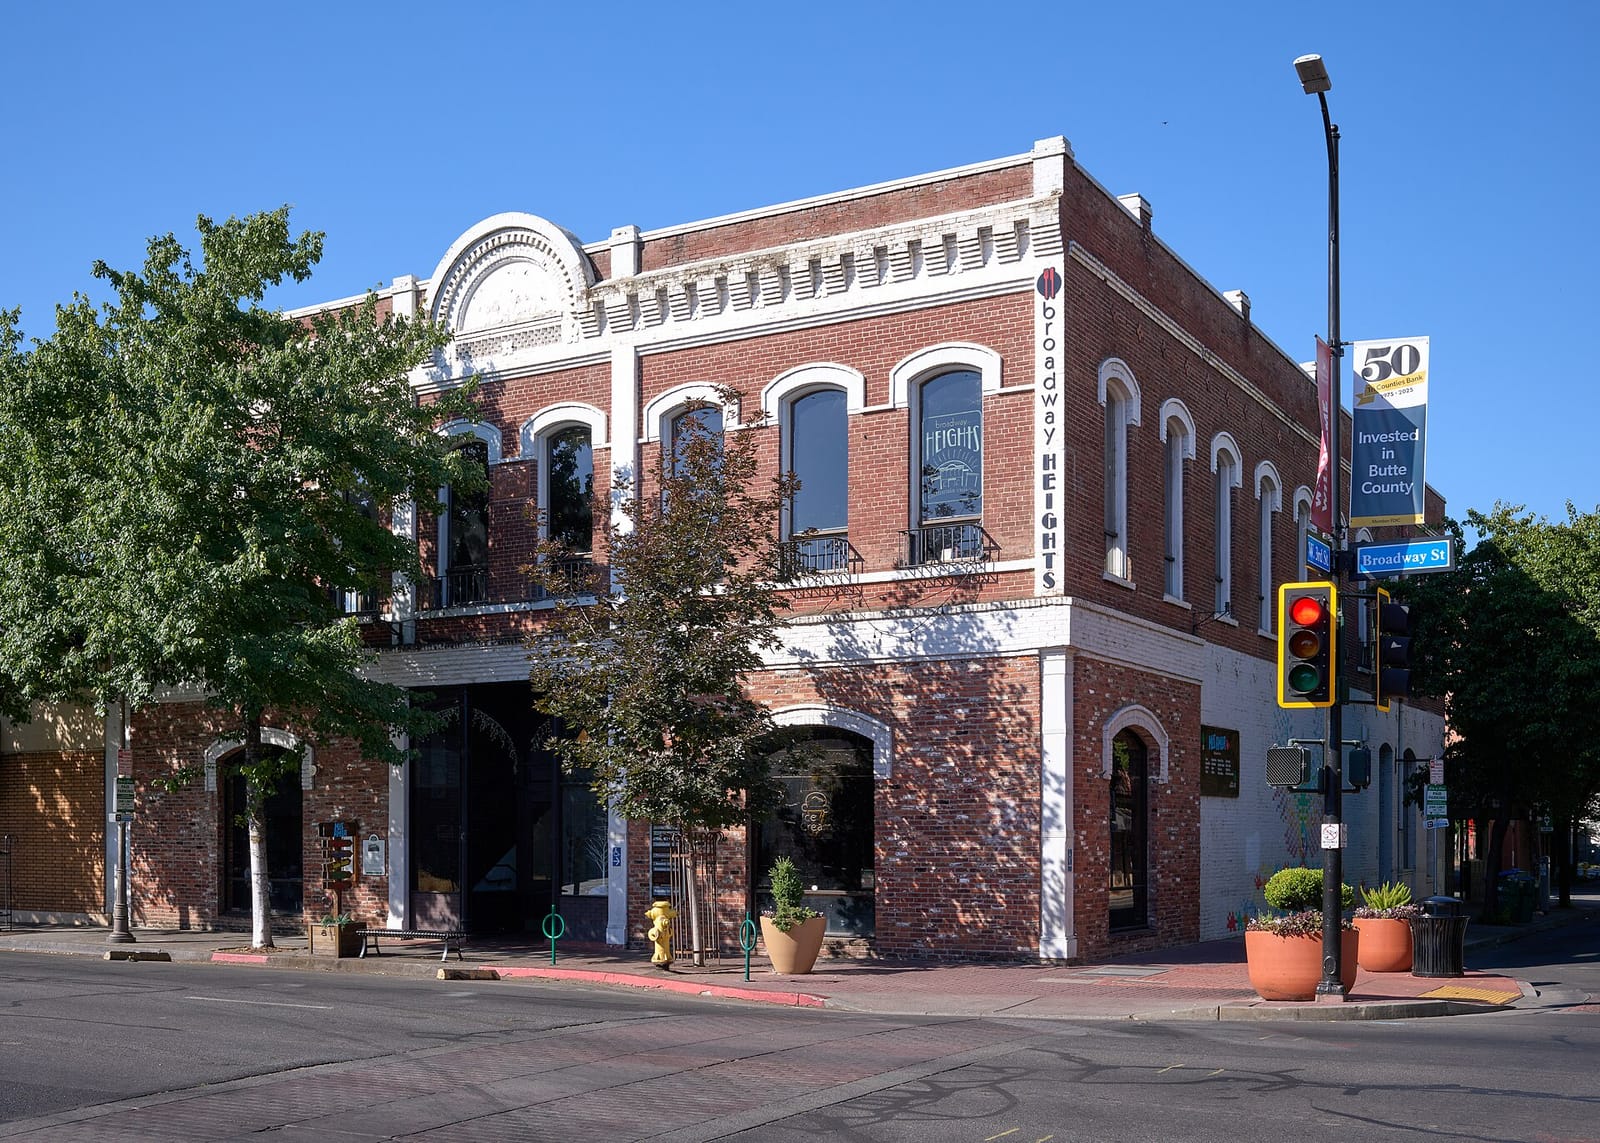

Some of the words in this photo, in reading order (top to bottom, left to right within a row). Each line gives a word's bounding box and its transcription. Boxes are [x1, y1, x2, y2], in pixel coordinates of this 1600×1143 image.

[1361, 344, 1421, 382] 50
[1041, 301, 1058, 446] broadway
[1376, 378, 1405, 391] Counties
[1406, 374, 1423, 384] Bank
[1398, 387, 1414, 395] 2025
[926, 425, 980, 461] HEIGHTS
[1359, 428, 1419, 444] Invested
[1382, 447, 1395, 459] in
[1369, 464, 1407, 477] Butte
[1361, 481, 1414, 495] County
[1042, 453, 1057, 590] HEIGHTS
[1315, 546, 1323, 563] 3rd
[1323, 550, 1329, 566] St
[1362, 552, 1427, 566] Broadway
[1431, 548, 1446, 561] St
